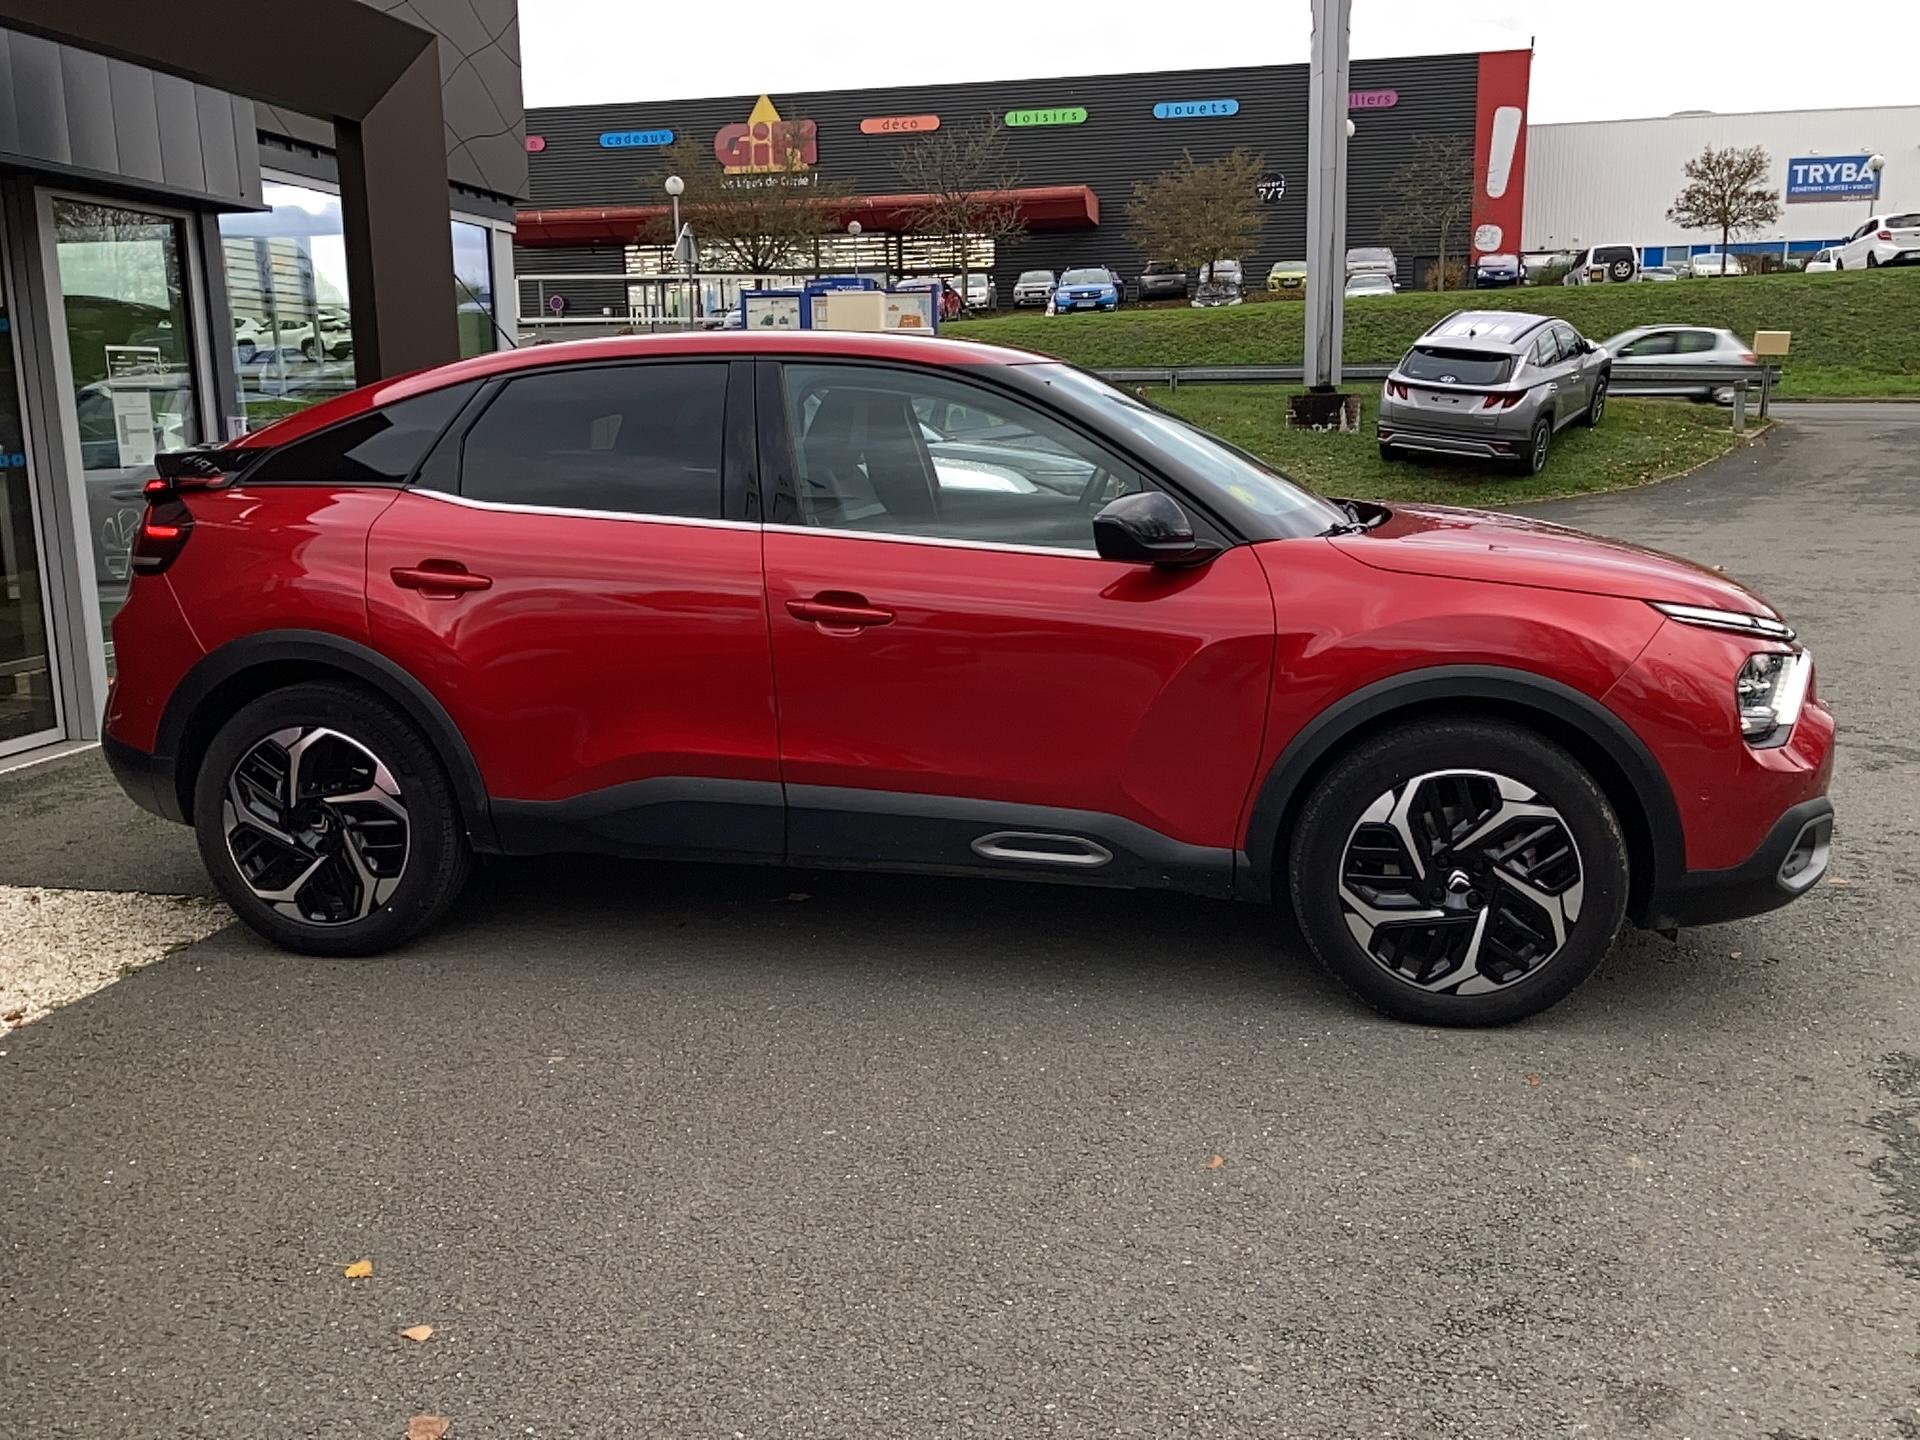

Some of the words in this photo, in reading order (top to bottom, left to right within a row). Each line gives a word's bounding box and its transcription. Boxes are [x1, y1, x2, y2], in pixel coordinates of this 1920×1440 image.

[1166, 103, 1228, 116] jouets
[882, 117, 918, 130] déco
[1014, 111, 1077, 123] loisirs
[607, 133, 667, 146] cadeaux
[1792, 163, 1874, 184] TRYBA
[1258, 188, 1284, 200] 7/7
